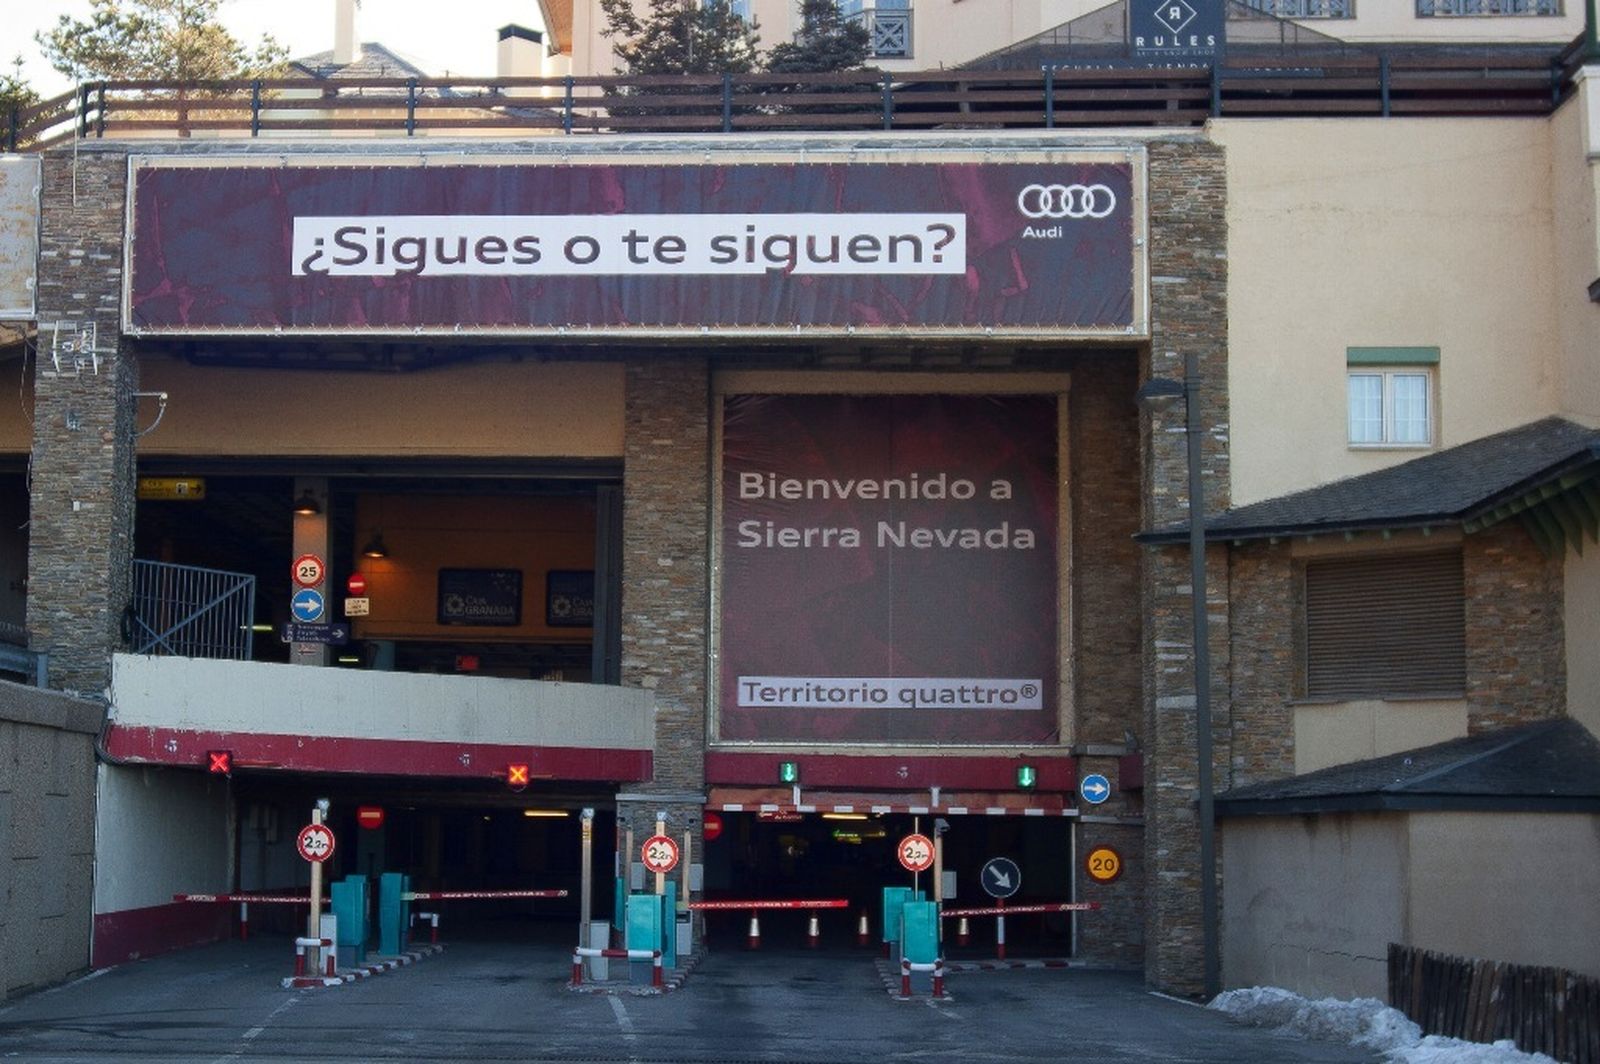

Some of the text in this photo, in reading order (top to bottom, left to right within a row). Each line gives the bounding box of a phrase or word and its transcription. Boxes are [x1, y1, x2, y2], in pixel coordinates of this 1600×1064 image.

[1135, 35, 1216, 47] RULES
[1022, 226, 1063, 239] Audi
[302, 223, 956, 276] ¿Sigues o te siguen?
[739, 472, 1013, 500] Bienvenido a
[737, 520, 1036, 549] Sierra Nevada
[300, 566, 317, 577] 25
[742, 682, 889, 704] Territorio
[1092, 858, 1116, 871] 20
